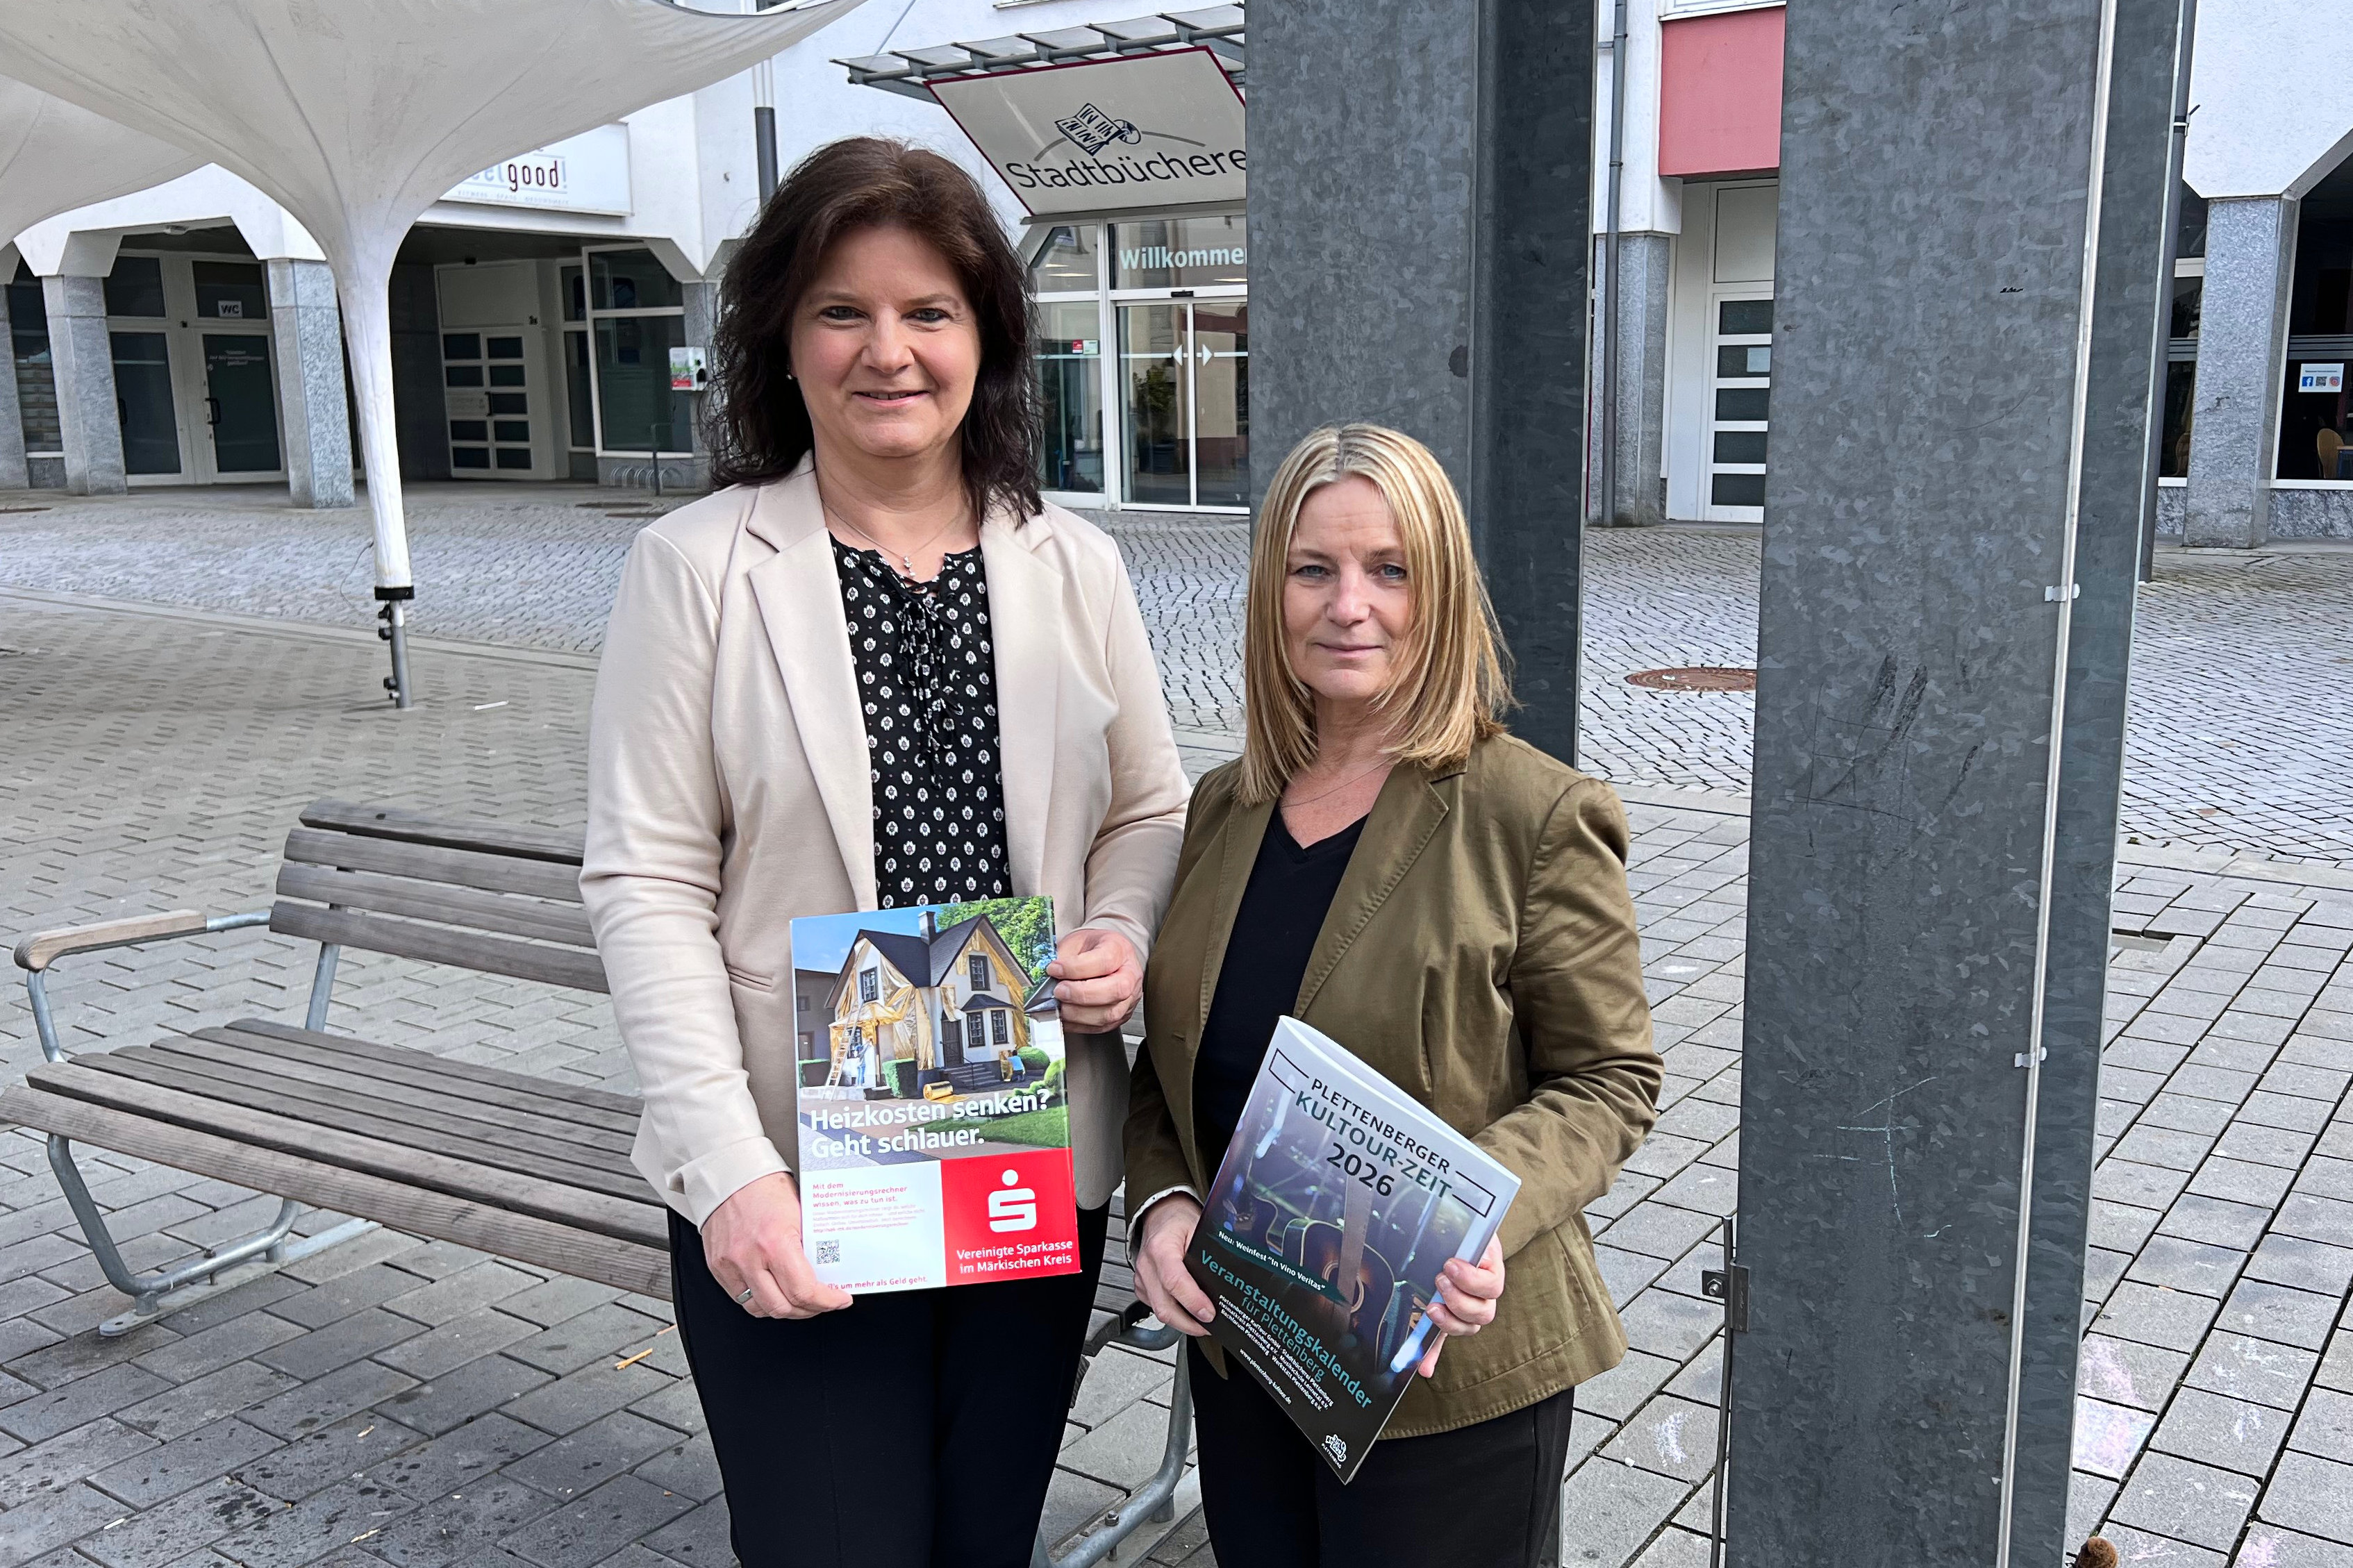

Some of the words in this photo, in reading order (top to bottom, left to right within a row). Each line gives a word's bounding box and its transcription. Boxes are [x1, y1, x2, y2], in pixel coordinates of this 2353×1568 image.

[1006, 149, 1247, 188] Stadtbüchere
[1119, 246, 1247, 270] Willkomme
[221, 304, 240, 314] WC
[811, 1103, 946, 1131] Heizkosten
[952, 1088, 1050, 1119] senken?
[1311, 1078, 1450, 1174] PLETTENBERGER
[811, 1134, 871, 1158] Geht
[878, 1126, 985, 1154] schlauer.
[1295, 1090, 1452, 1198] KULTOUR-ZEIT
[1327, 1142, 1395, 1196] 2026
[813, 1186, 908, 1199] Modernisierungsrechner
[956, 1246, 1014, 1260] Vereinigte
[1016, 1241, 1073, 1256] Sparkasse
[960, 1263, 974, 1274] im
[977, 1258, 1041, 1272] Märkischen
[1043, 1253, 1072, 1266] Kreis
[1218, 1231, 1235, 1246] Neu:
[1236, 1240, 1267, 1262] Weinfest
[1280, 1262, 1297, 1276] Vino
[889, 1277, 906, 1285] Geld
[1202, 1250, 1372, 1408] Veranstaltungskalender
[1241, 1296, 1261, 1316] für
[1261, 1312, 1327, 1383] Plettenberg
